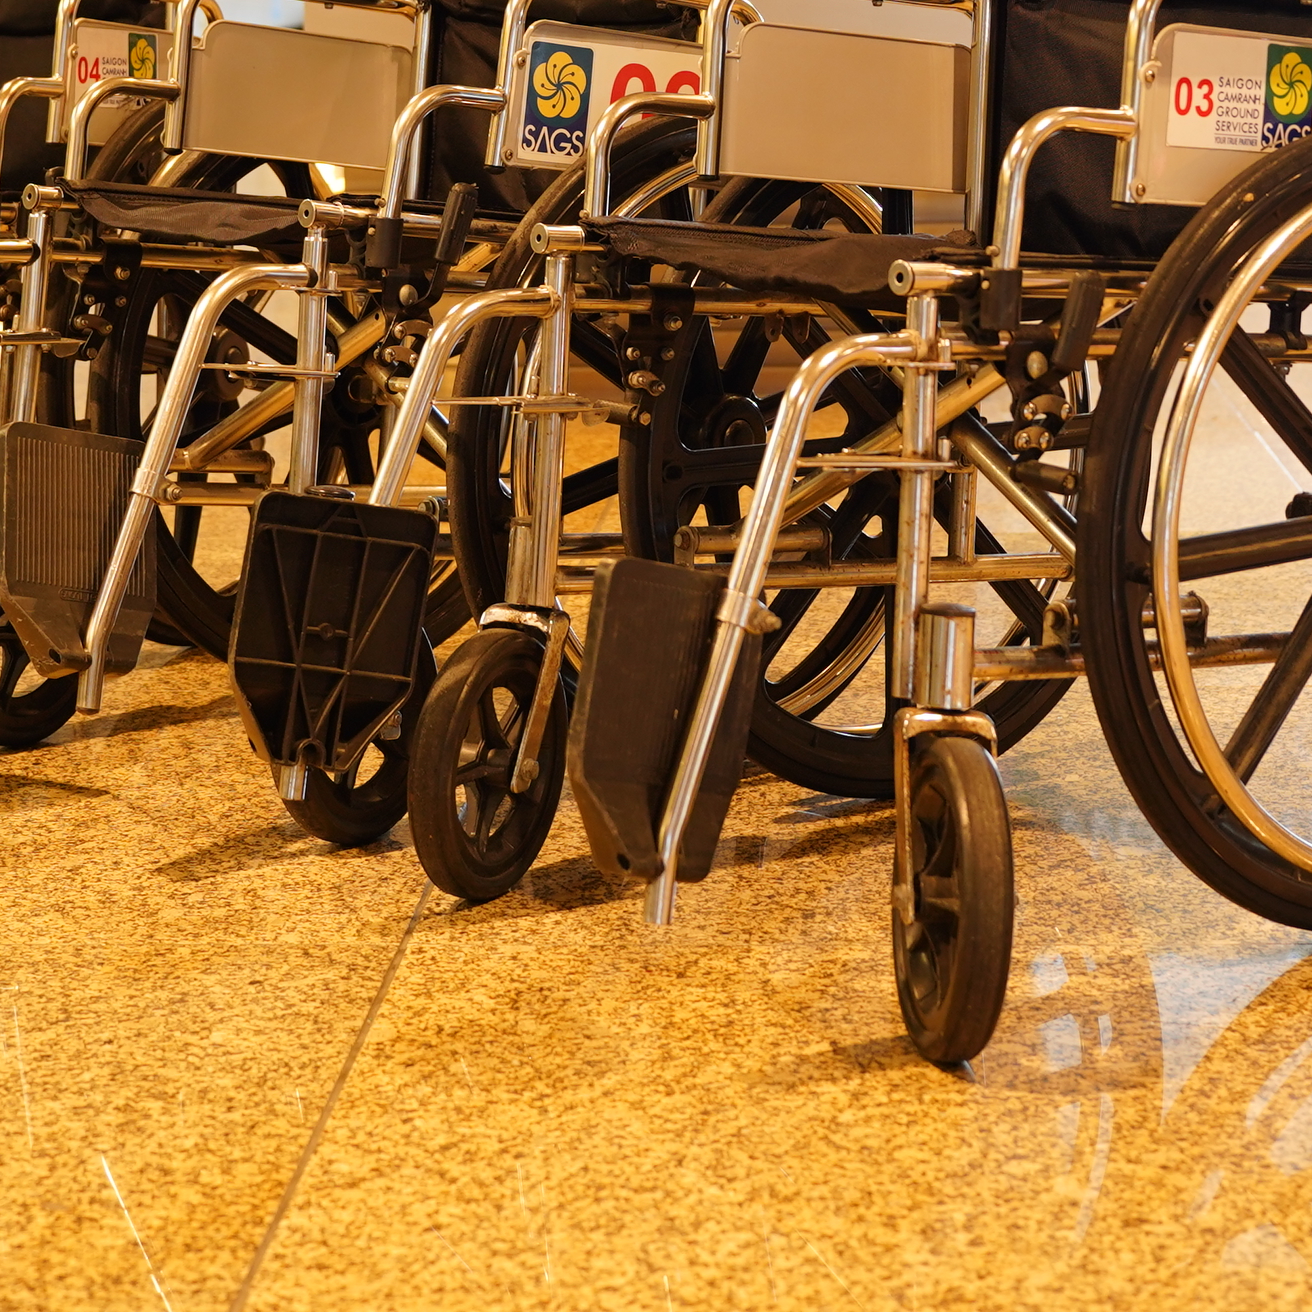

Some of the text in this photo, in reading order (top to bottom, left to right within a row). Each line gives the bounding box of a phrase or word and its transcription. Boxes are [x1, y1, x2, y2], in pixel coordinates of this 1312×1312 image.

[102, 57, 127, 66] SAIGON
[78, 56, 101, 84] 04
[102, 67, 127, 76] CAMRANH
[1218, 76, 1263, 90] SAIGON
[1174, 76, 1214, 118] 03
[1217, 91, 1262, 105] CAMRANH
[1215, 105, 1261, 120] GROUND
[1214, 120, 1259, 135] SERVICES
[522, 124, 585, 157] SAGS
[1214, 136, 1258, 147] YOUR TRUE PARTNER
